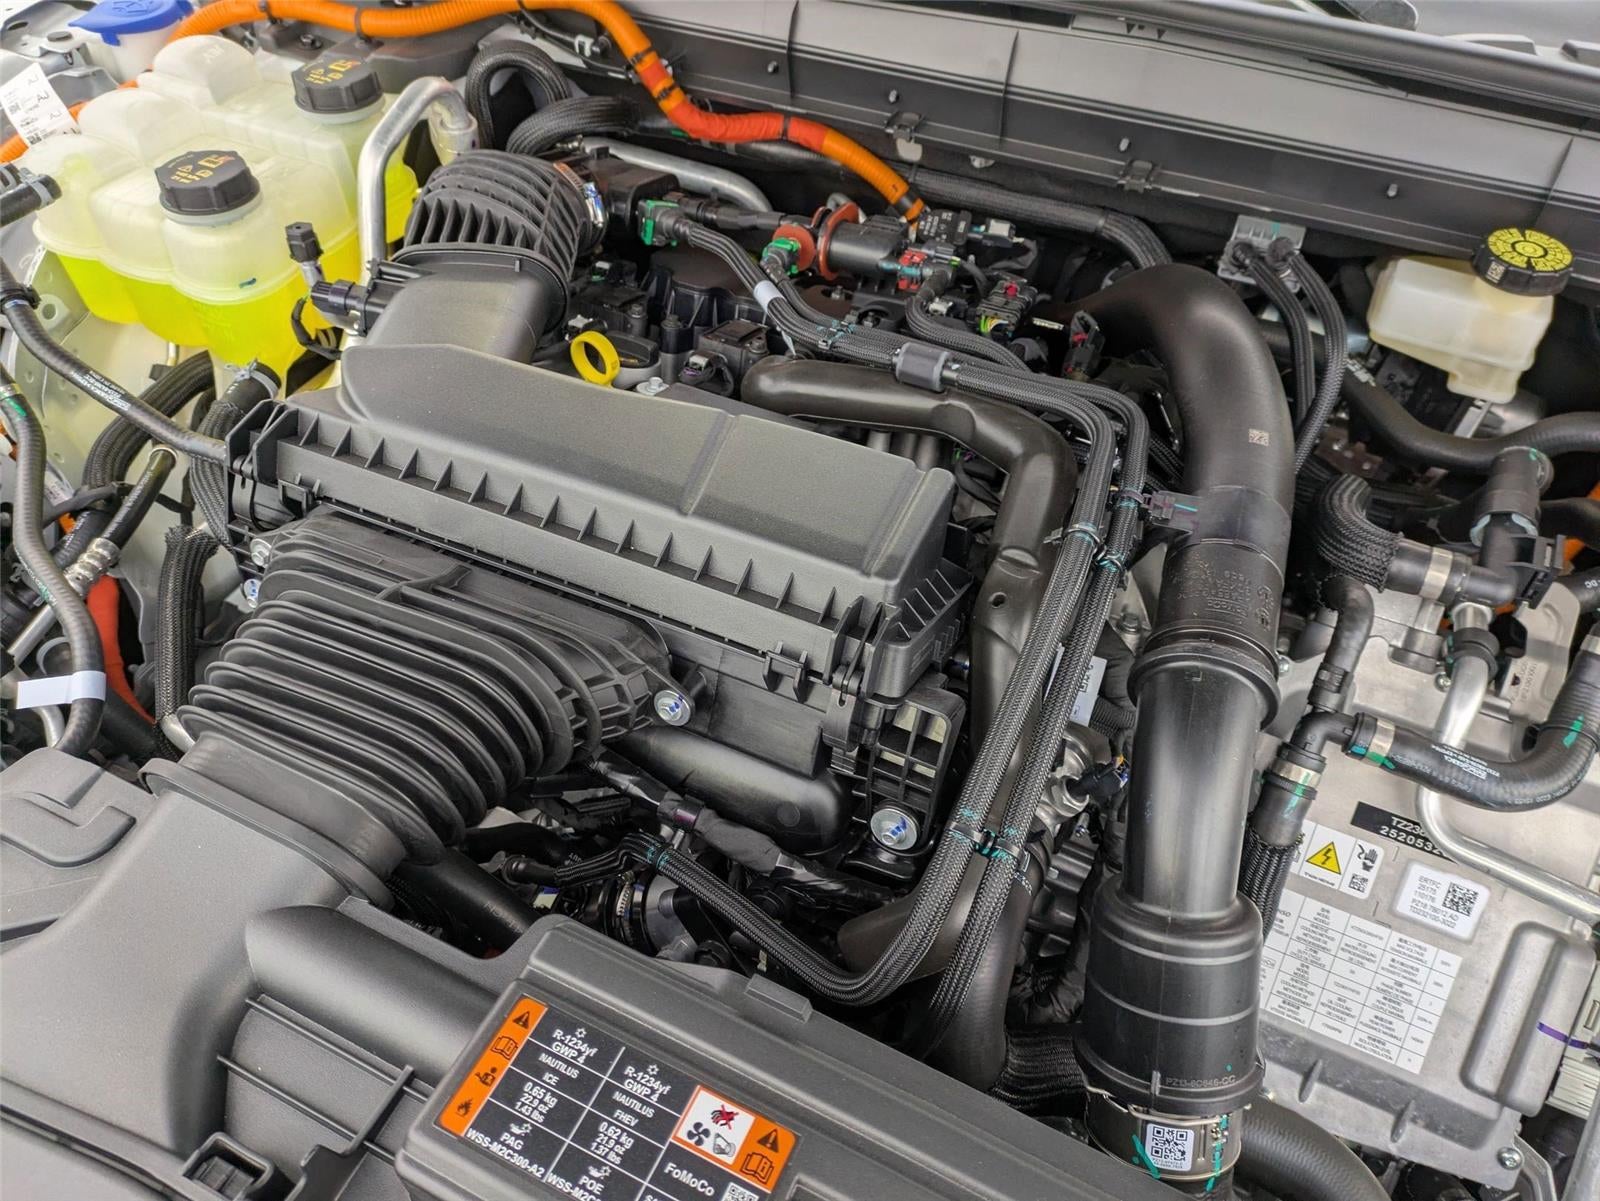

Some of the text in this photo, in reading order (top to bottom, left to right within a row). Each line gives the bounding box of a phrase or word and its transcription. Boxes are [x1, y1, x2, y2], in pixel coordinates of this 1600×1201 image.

[1380, 826, 1444, 853] 2520532
[551, 1041, 586, 1064] GWP 4
[552, 1028, 598, 1057] R-1234yf
[538, 1053, 580, 1079] NAUTILUS
[542, 1072, 560, 1086] ICE
[624, 1065, 671, 1095] R-1234yf
[624, 1079, 659, 1102] GWP 4
[519, 1093, 548, 1114] 22.9 oz
[523, 1082, 558, 1107] 0.65 kg
[612, 1090, 655, 1118] NAUTILUS
[514, 1101, 545, 1123] 1.43 lbs
[613, 1109, 639, 1127] FHEV
[500, 1132, 523, 1151] PAG
[595, 1133, 626, 1155] 21.9 oz
[598, 1121, 634, 1149] 0.62 kg
[466, 1127, 545, 1178] WSS-M2C300-A2
[590, 1140, 622, 1165] 1.37 lbs
[578, 1175, 605, 1195] POE
[663, 1163, 717, 1197] FoMoCo
